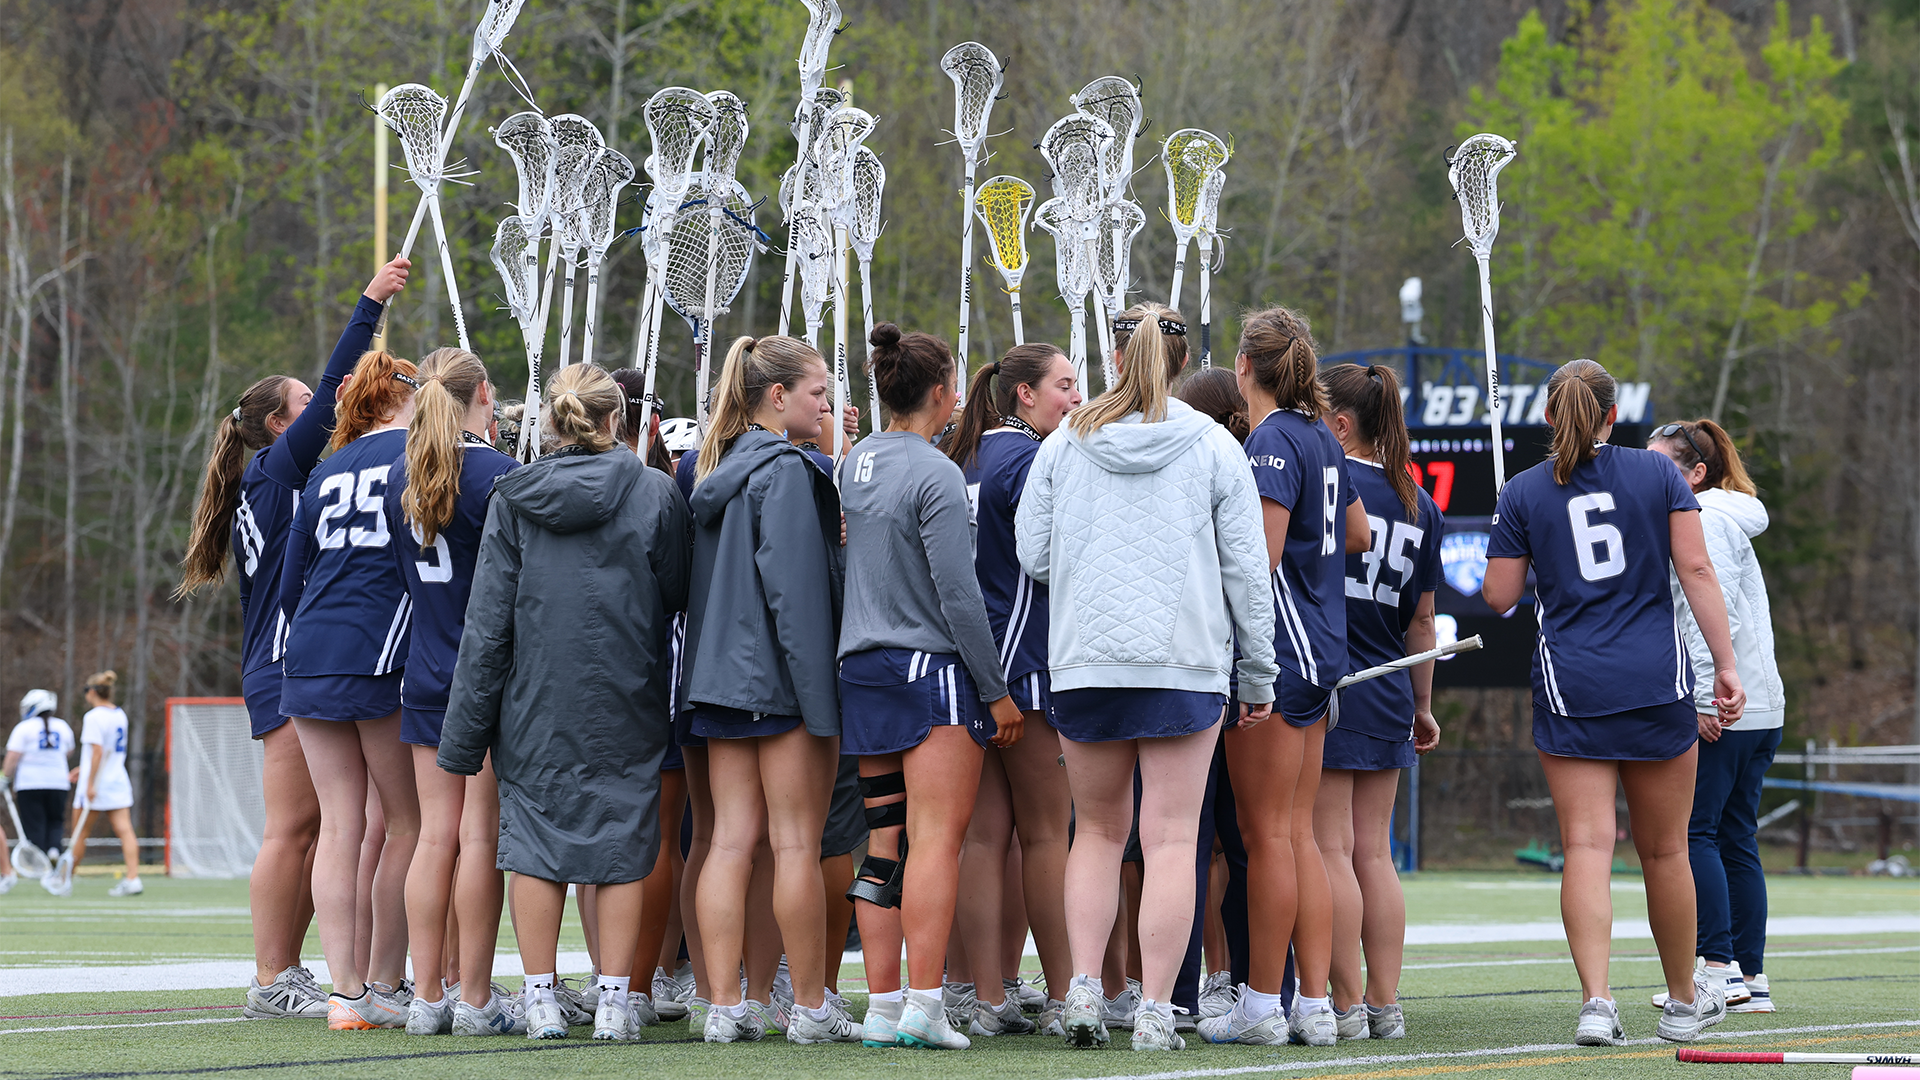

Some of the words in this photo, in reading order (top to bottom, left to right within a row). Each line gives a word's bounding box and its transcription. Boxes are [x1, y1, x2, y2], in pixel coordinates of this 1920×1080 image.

[789, 210, 801, 251] HAWKS
[964, 266, 972, 304] HAWKS
[396, 373, 414, 384] GAIT
[838, 342, 846, 383] HAWKS
[1421, 380, 1480, 426] '83
[1005, 419, 1022, 428] GAIT
[1023, 427, 1041, 441] GAIT
[853, 451, 877, 483] 15
[315, 464, 392, 551] 25
[1321, 465, 1339, 557] 19
[1566, 491, 1625, 582] 6
[1345, 513, 1425, 608] 35
[115, 727, 126, 752] 2
[1866, 1055, 1912, 1064] HAWKS
